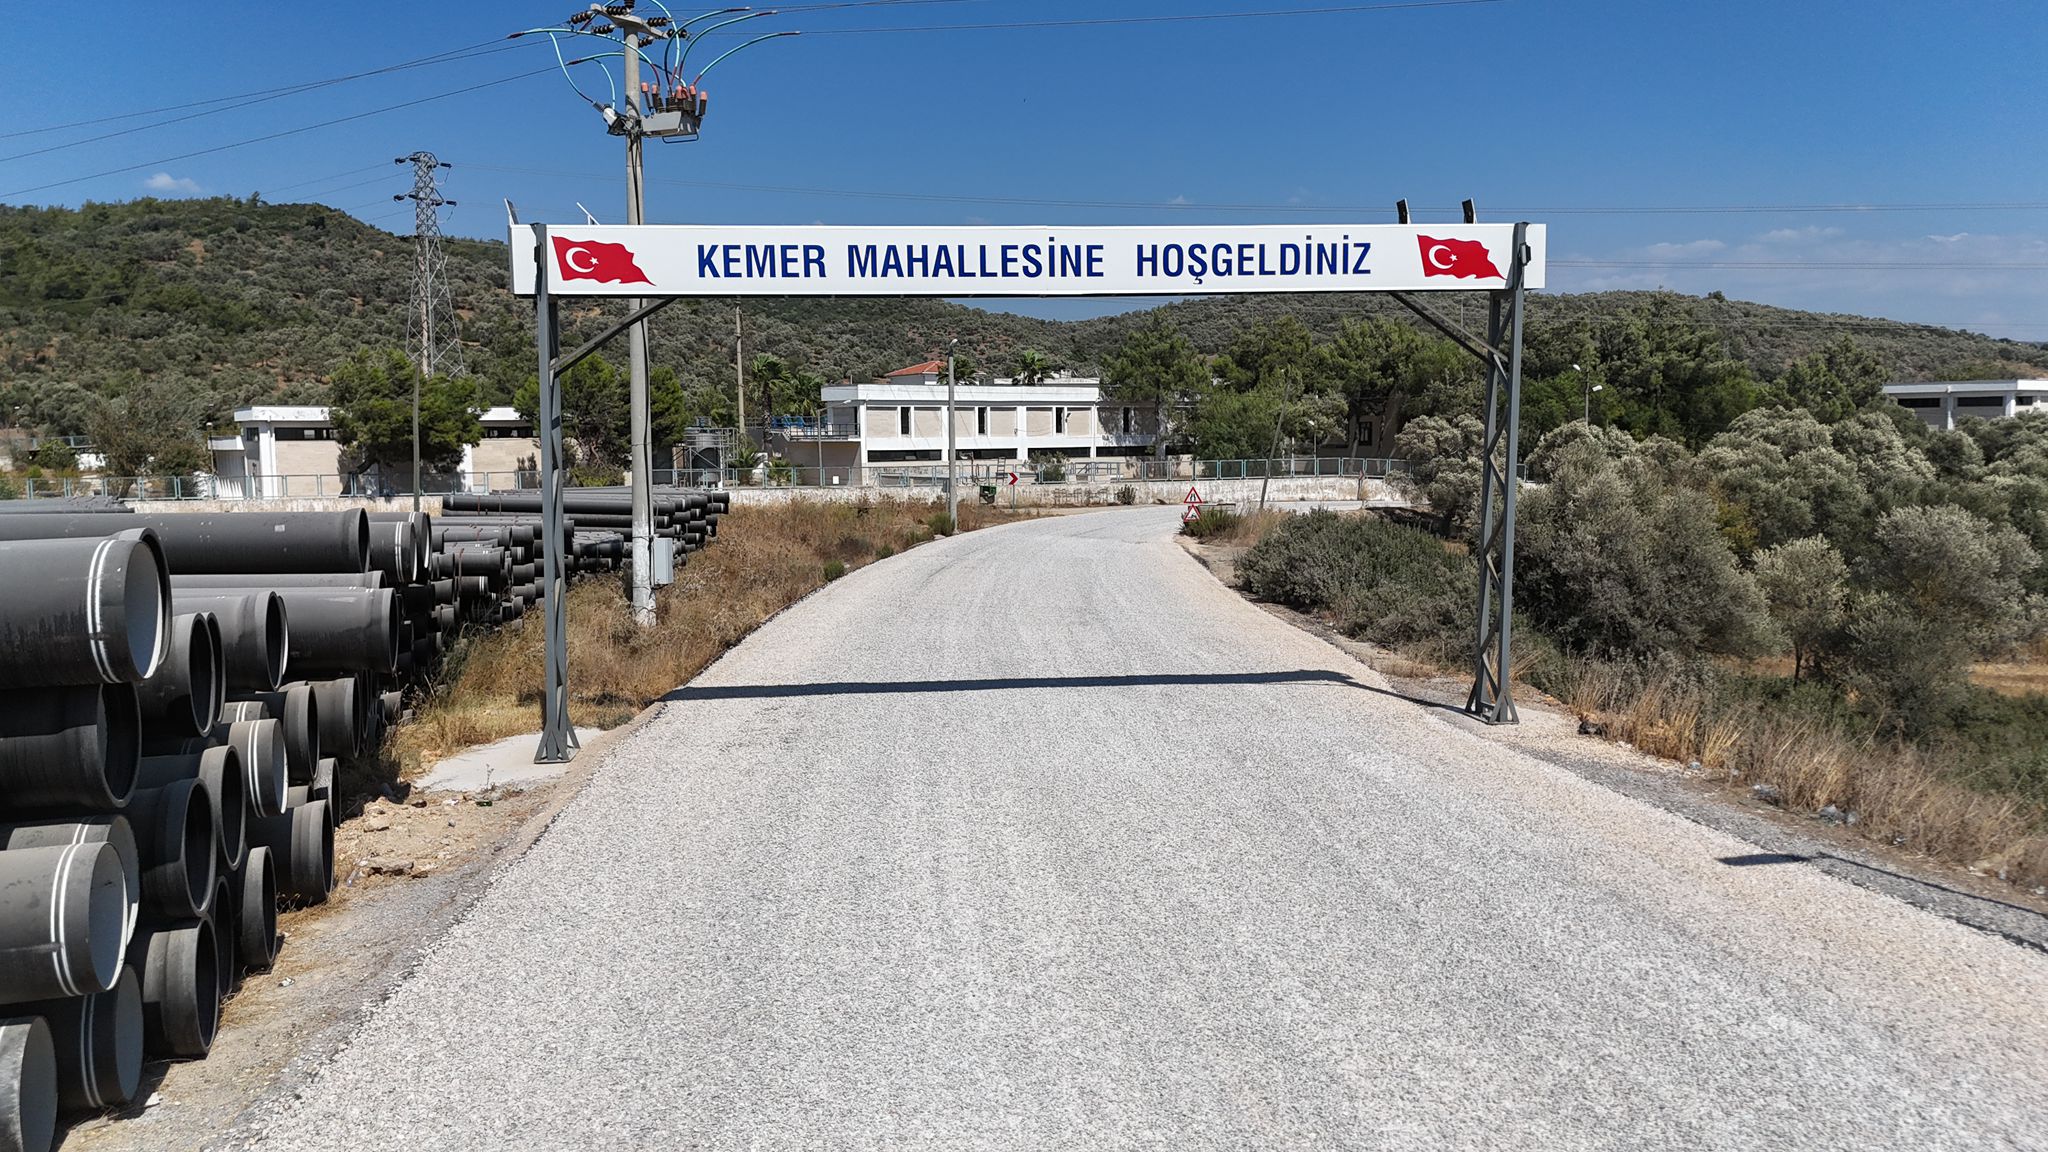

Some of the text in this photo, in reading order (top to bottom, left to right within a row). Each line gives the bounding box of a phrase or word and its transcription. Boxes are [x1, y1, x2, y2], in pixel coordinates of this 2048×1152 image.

[698, 235, 1371, 285] KEMER MAHALLESİNE HOŞGELDİNİZ
